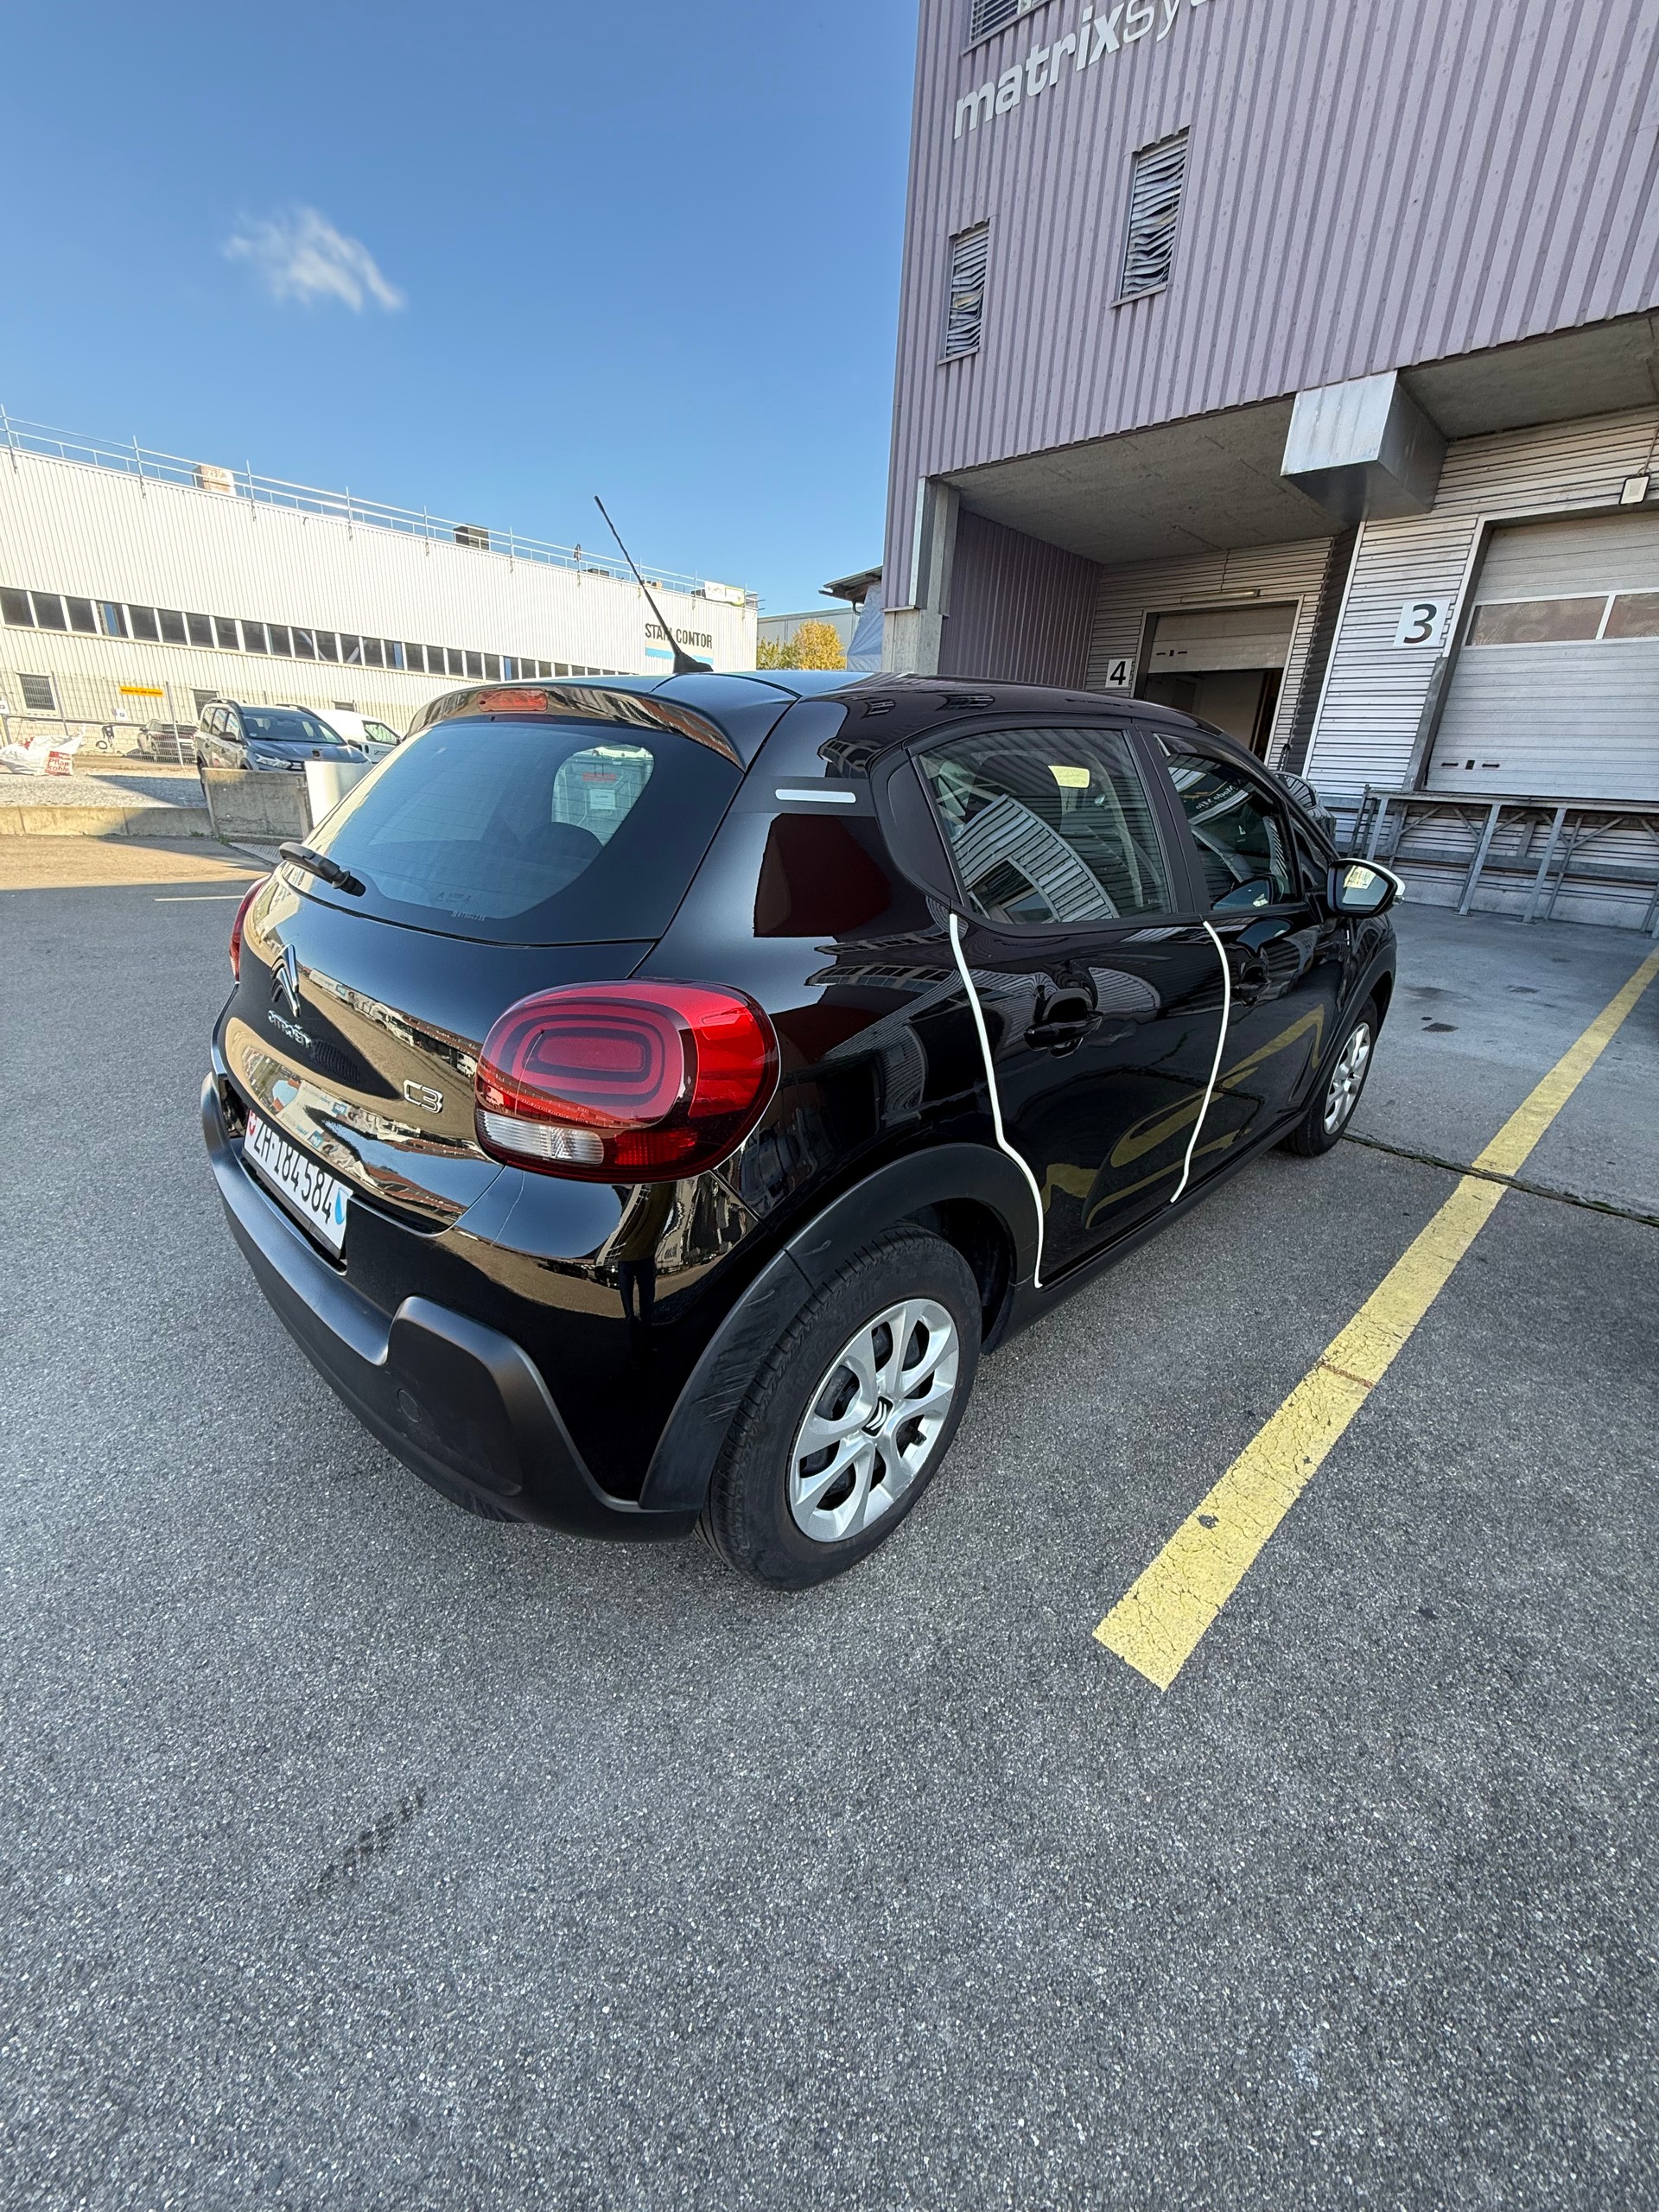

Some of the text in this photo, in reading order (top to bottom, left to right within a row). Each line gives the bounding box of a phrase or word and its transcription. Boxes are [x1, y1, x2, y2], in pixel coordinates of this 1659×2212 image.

[954, 0, 1208, 139] matrixsy
[676, 628, 713, 649] CONTOR
[1403, 604, 1437, 644] 3
[1109, 661, 1127, 685] 4
[404, 1079, 443, 1114] C3
